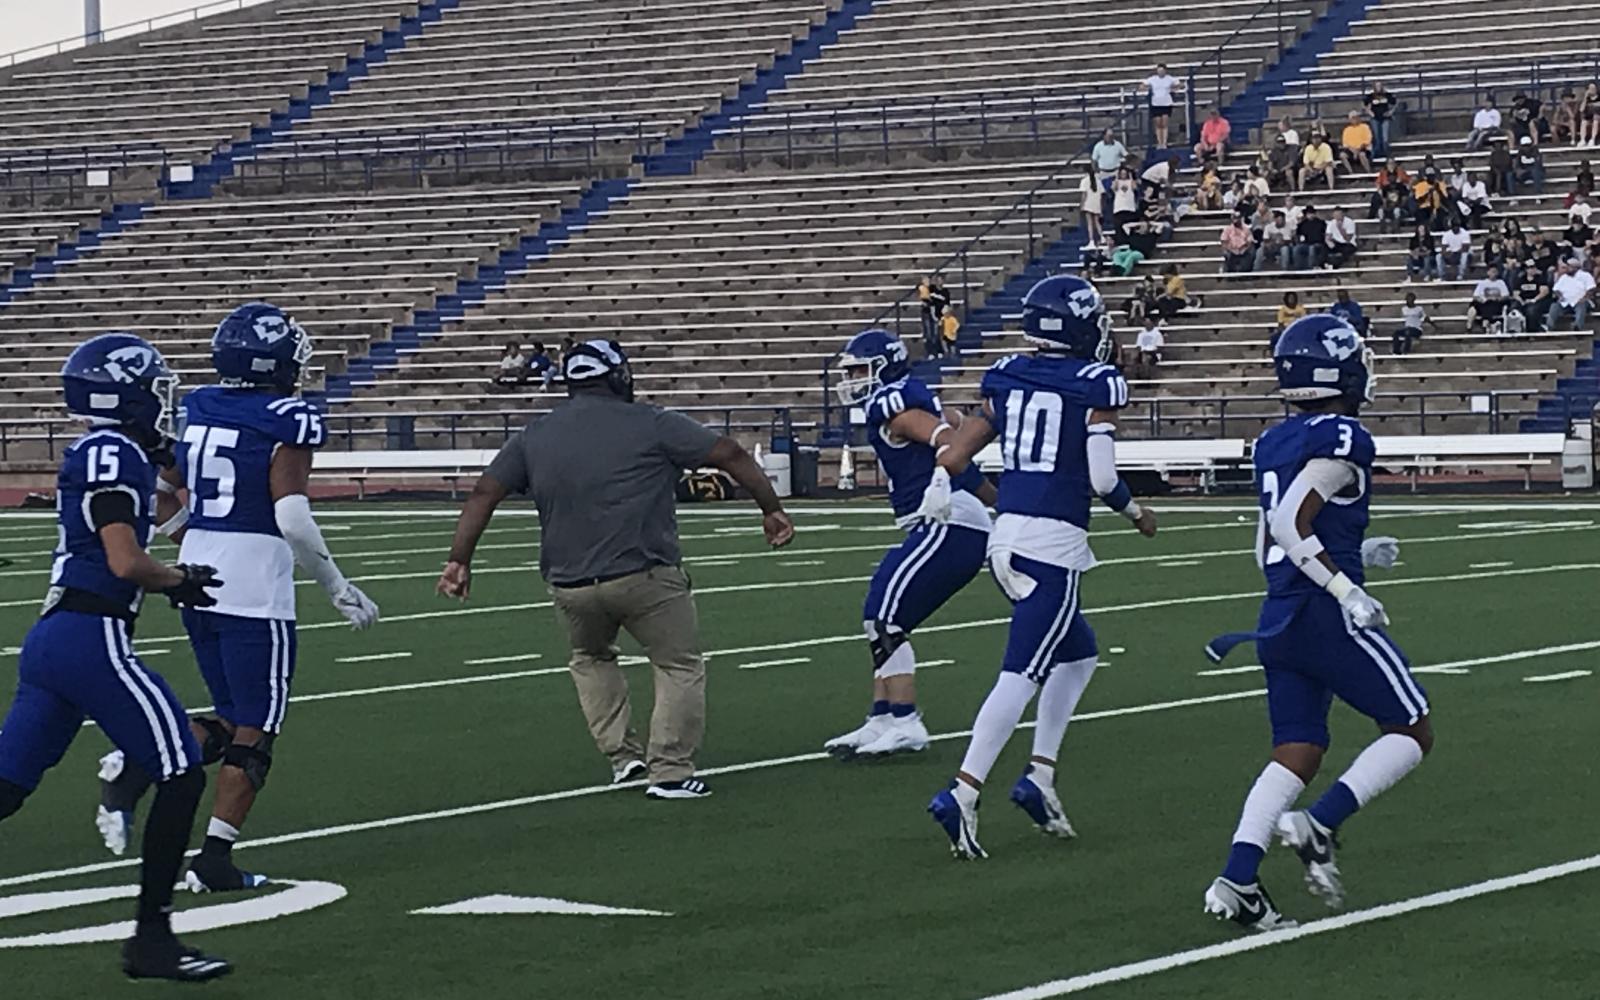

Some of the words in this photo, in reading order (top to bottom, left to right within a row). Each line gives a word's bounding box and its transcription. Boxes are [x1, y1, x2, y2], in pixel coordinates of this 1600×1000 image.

[876, 390, 905, 418] 70
[1106, 376, 1129, 407] 10
[293, 413, 322, 445] 75
[1005, 390, 1063, 472] 10
[1334, 424, 1353, 456] 3
[87, 445, 120, 483] 15
[183, 425, 240, 518] 75
